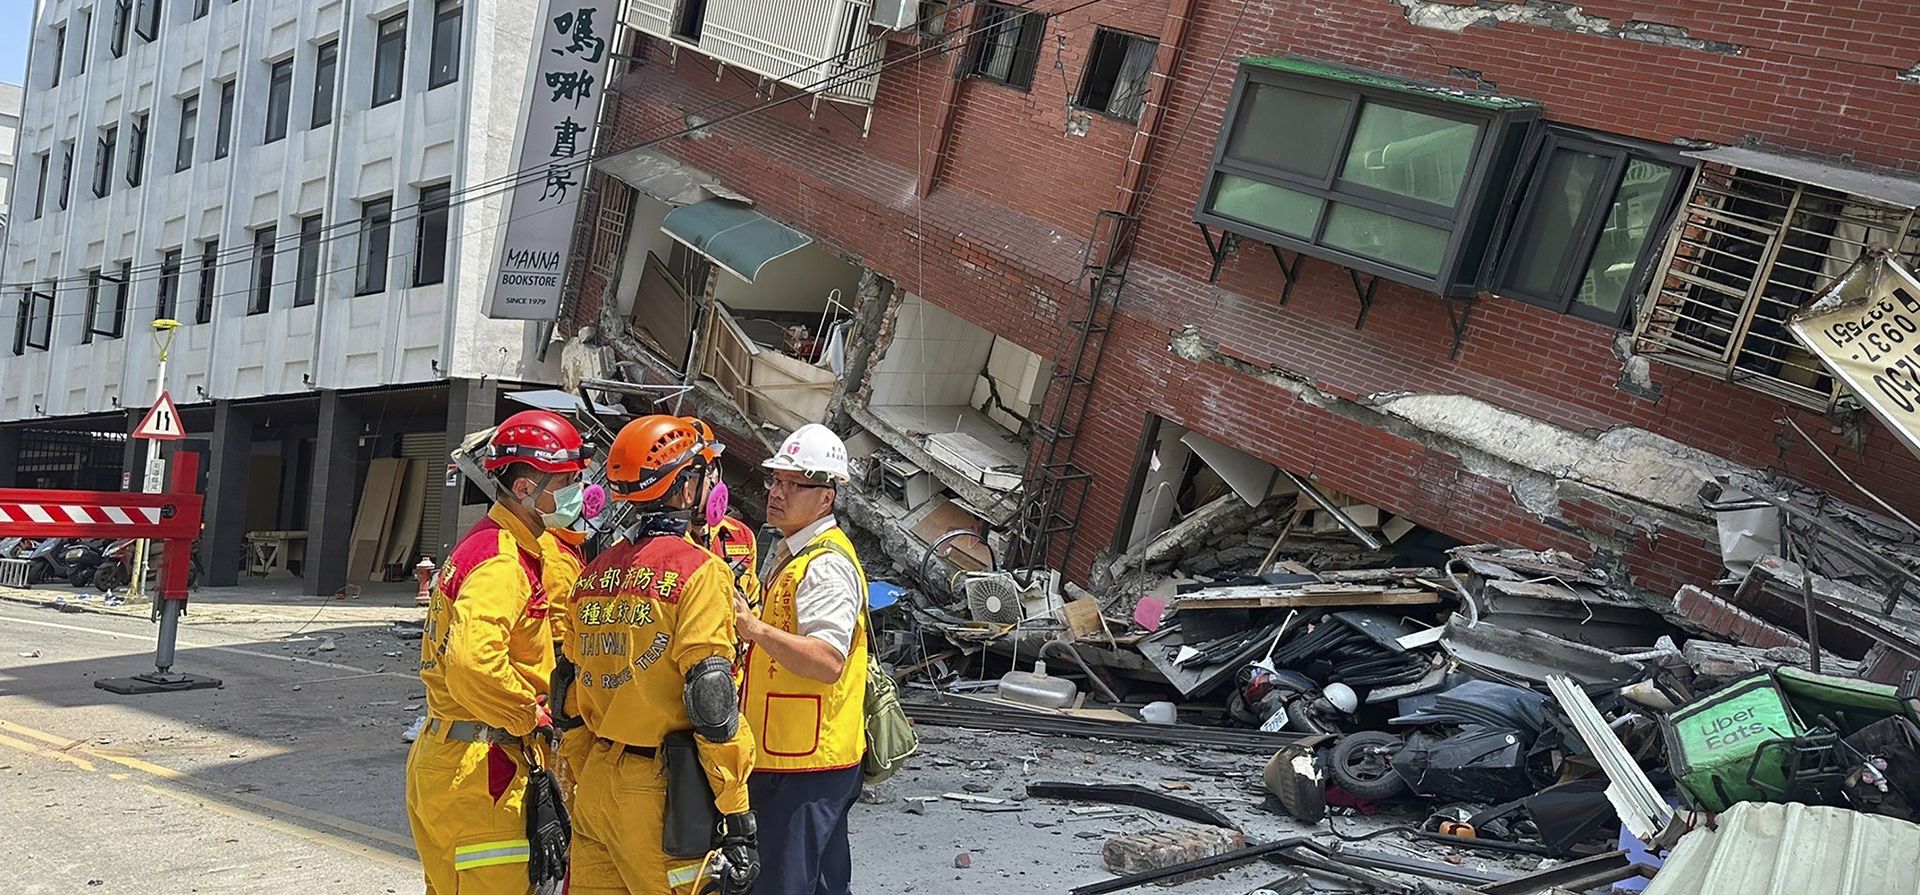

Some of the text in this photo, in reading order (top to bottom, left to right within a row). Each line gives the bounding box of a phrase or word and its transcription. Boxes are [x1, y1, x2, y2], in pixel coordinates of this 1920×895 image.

[538, 7, 605, 205] 嗎哪書房
[505, 247, 560, 271] MANNA
[502, 274, 557, 287] BOOKSTORE
[505, 297, 527, 305] SINCE
[579, 631, 627, 656] TAIWAN
[582, 670, 593, 688] &
[634, 631, 671, 671] TEAM
[1701, 705, 1756, 736] Uber
[1706, 721, 1765, 751] Eats
